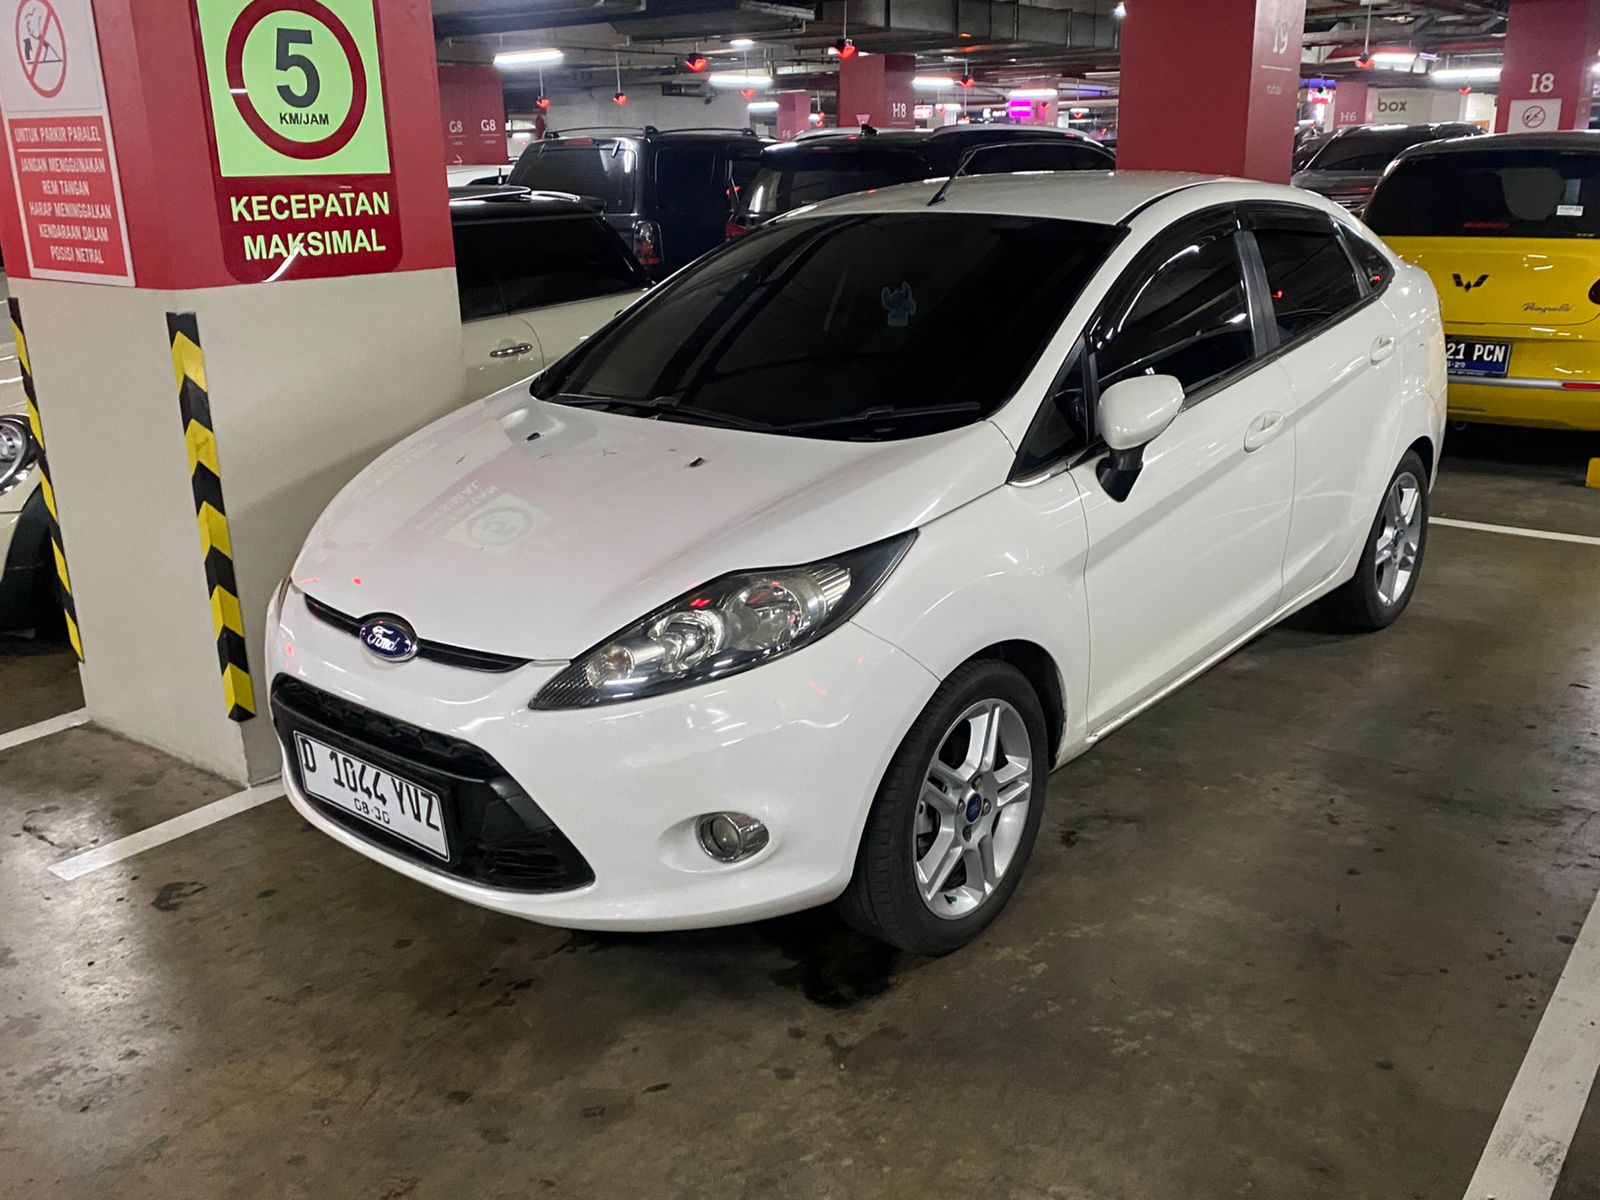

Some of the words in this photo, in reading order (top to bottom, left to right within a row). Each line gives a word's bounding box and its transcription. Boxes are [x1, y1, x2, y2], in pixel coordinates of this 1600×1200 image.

[276, 28, 320, 108] 5
[1530, 73, 1554, 93] I8
[892, 102, 907, 118] H8
[1377, 99, 1408, 112] box
[279, 113, 329, 125] KM/JAM
[449, 120, 463, 133] G8
[481, 119, 496, 131] G8
[15, 127, 40, 142] UNTUK
[40, 126, 67, 142] PARKIR
[67, 125, 101, 142] PARALEL
[21, 157, 48, 172] JANGAN
[48, 157, 106, 173] MENGGUNAKAN
[41, 180, 59, 195] REM
[59, 180, 90, 196] TANGAN
[28, 202, 52, 217] HARAP
[53, 203, 112, 219] MENINGGALKAN
[230, 191, 390, 222] KECEPATAN
[38, 224, 81, 240] KENDARAAN
[82, 226, 109, 242] DALAM
[243, 228, 386, 260] MAKSIMAL
[50, 246, 75, 261] POSISI
[75, 248, 104, 264] NETRAL
[1473, 344, 1506, 362] PCN
[367, 625, 399, 652] Ford
[302, 738, 317, 773] D
[329, 752, 387, 806] 1044
